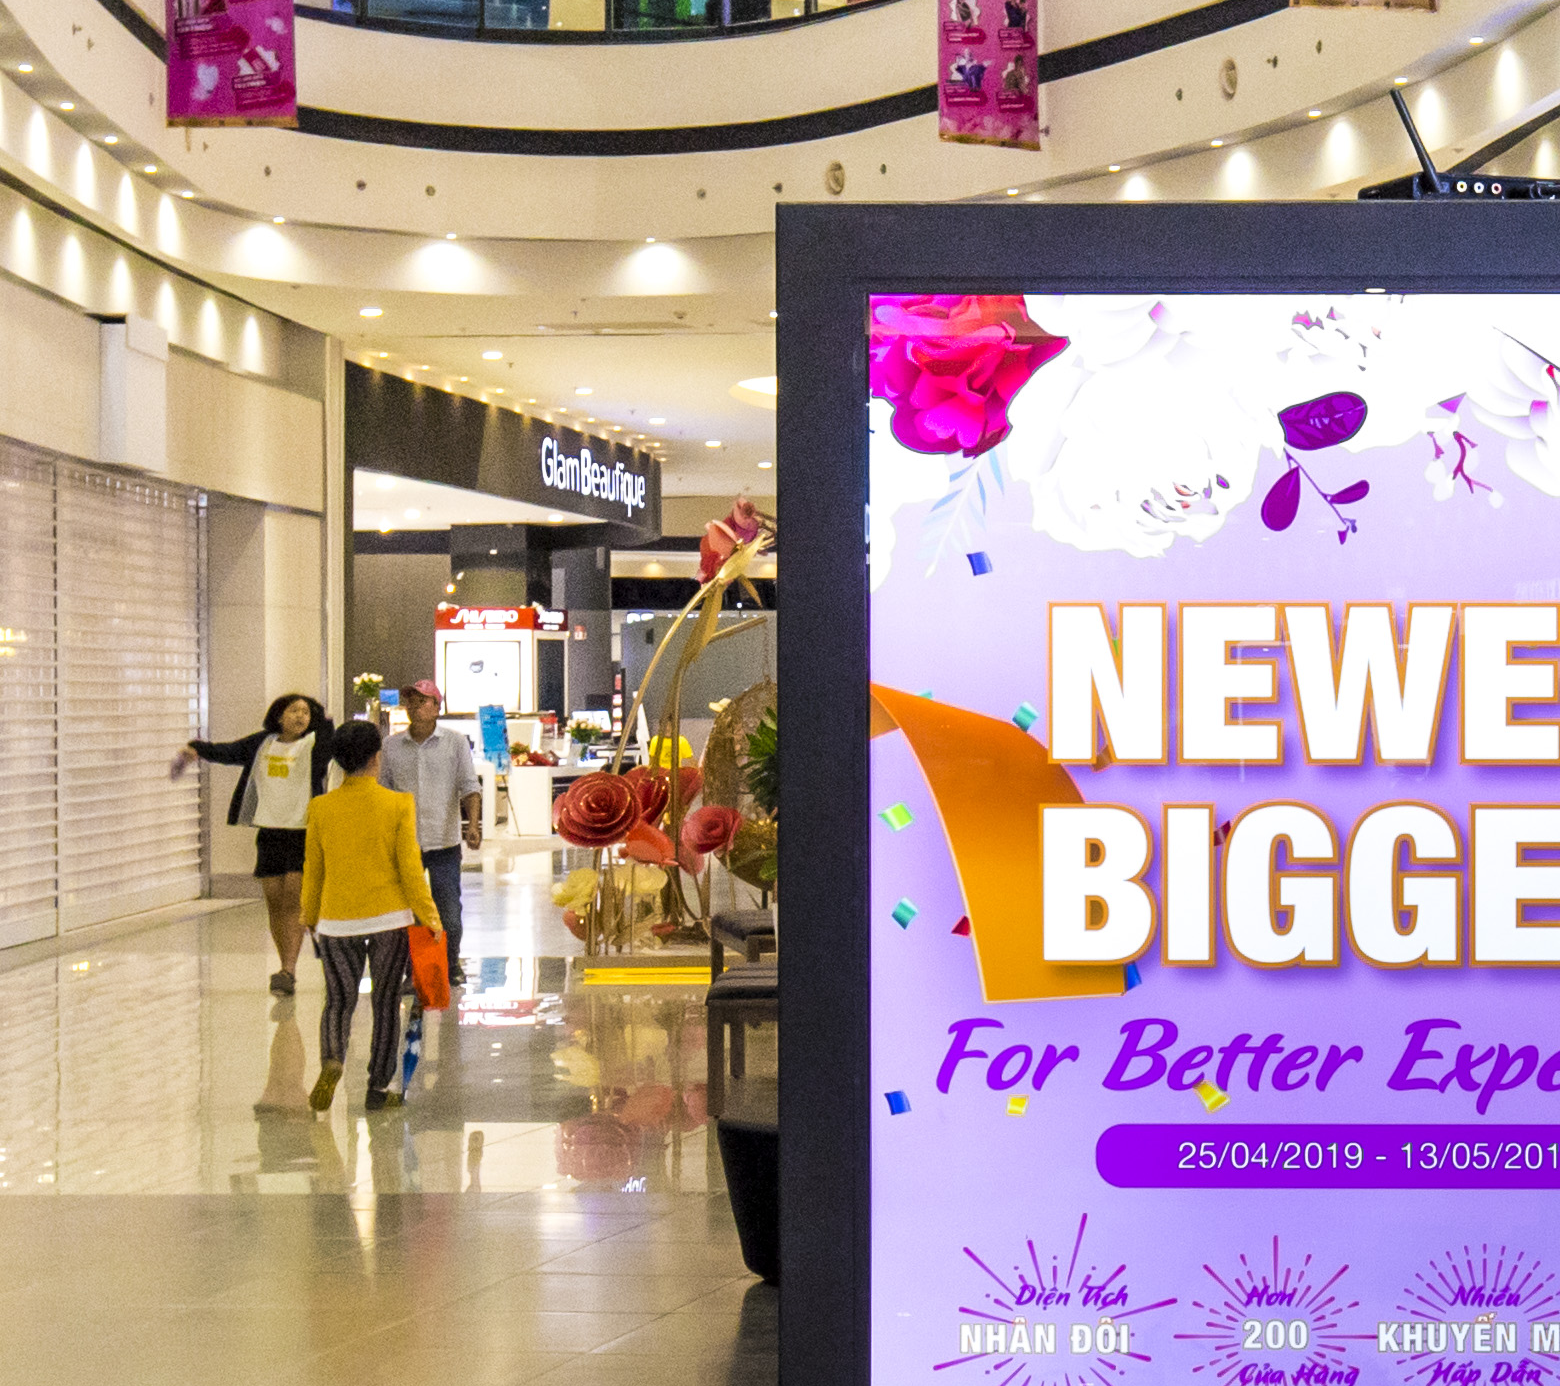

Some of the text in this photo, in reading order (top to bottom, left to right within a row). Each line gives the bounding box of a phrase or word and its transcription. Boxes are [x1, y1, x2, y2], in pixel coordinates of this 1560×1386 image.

[541, 436, 646, 518] GlamBeautique
[935, 1017, 1079, 1095] For
[1102, 1017, 1362, 1095] Better
[1177, 1140, 1363, 1173] 25/04/2019
[959, 1315, 1131, 1355] NHÂN ĐÔI
[1242, 1318, 1310, 1351] 200
[1376, 1311, 1518, 1355] KHUYẾN
